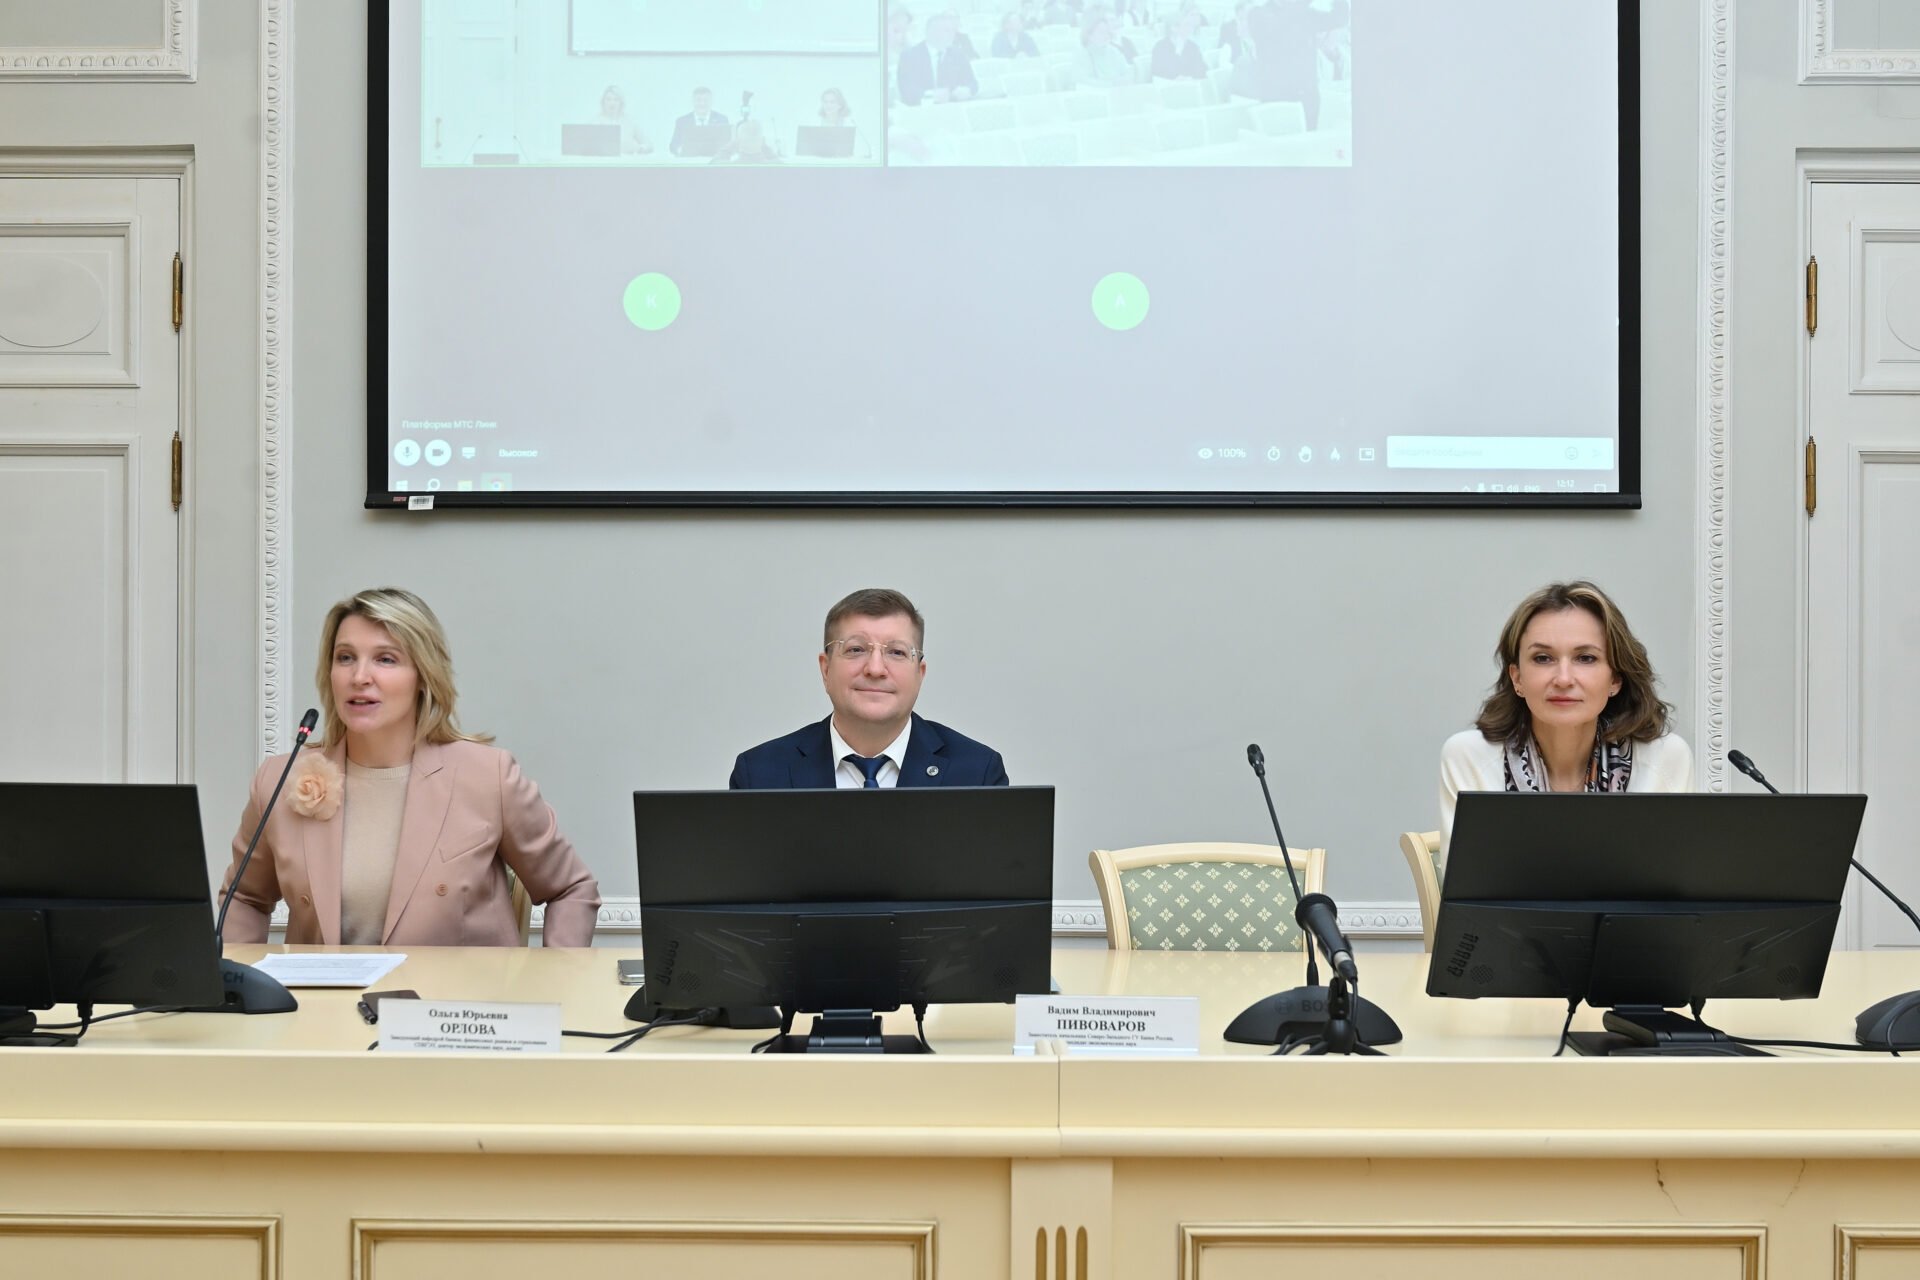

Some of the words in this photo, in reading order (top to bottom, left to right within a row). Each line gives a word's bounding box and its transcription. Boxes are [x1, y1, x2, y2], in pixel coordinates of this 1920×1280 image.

[402, 419, 452, 431] Платформа
[454, 420, 474, 429] МТС
[499, 448, 539, 458] Высокое
[1218, 447, 1247, 458] 100%
[429, 1008, 460, 1019] Ольга
[462, 1010, 509, 1021] Юрьевна
[1047, 1005, 1079, 1016] Вадим
[1082, 1006, 1156, 1018] Владимирович
[440, 1022, 497, 1036] ОРЛОВА
[1056, 1018, 1146, 1032] ПИВОВАРОВ
